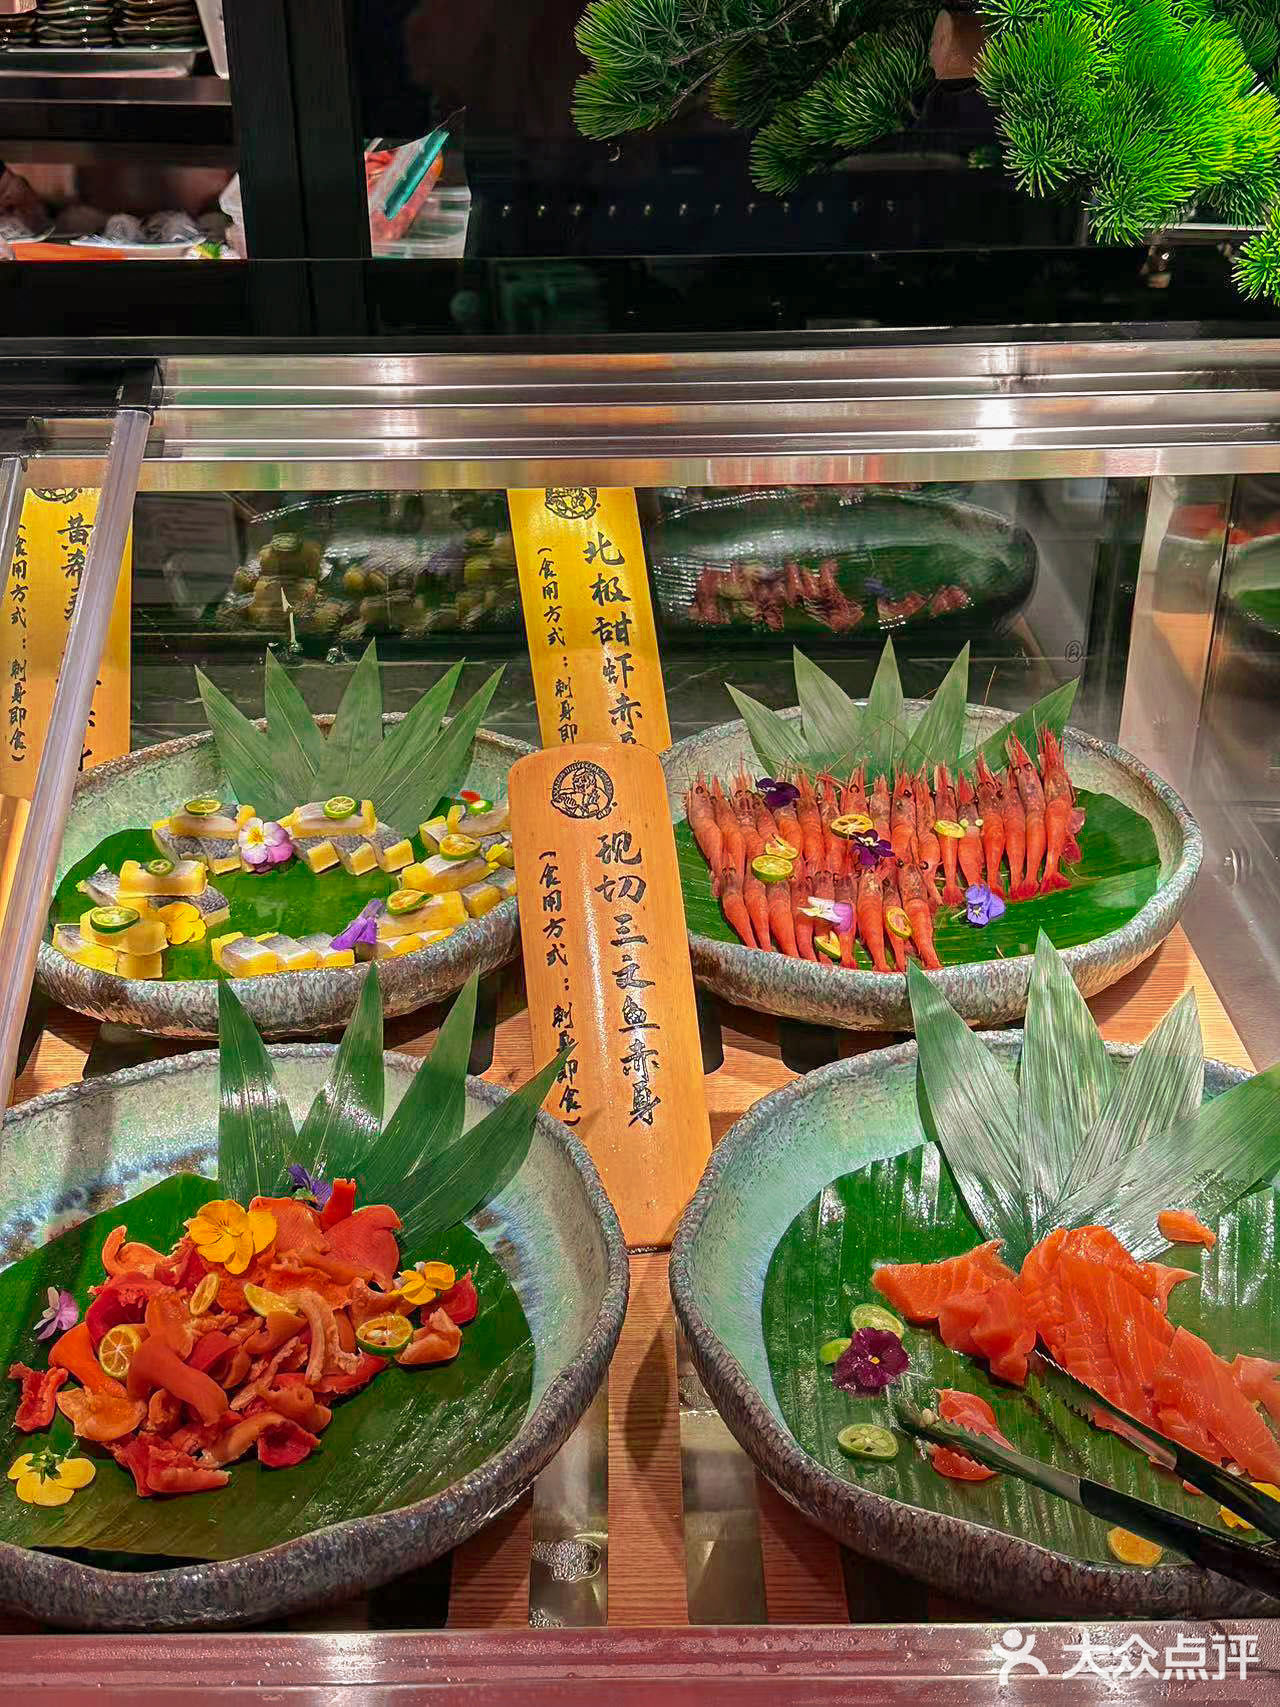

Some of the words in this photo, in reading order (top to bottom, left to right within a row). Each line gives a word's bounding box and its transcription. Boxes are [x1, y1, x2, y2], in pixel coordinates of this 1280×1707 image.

[594, 830, 662, 1127] 现切三文鱼赤身
